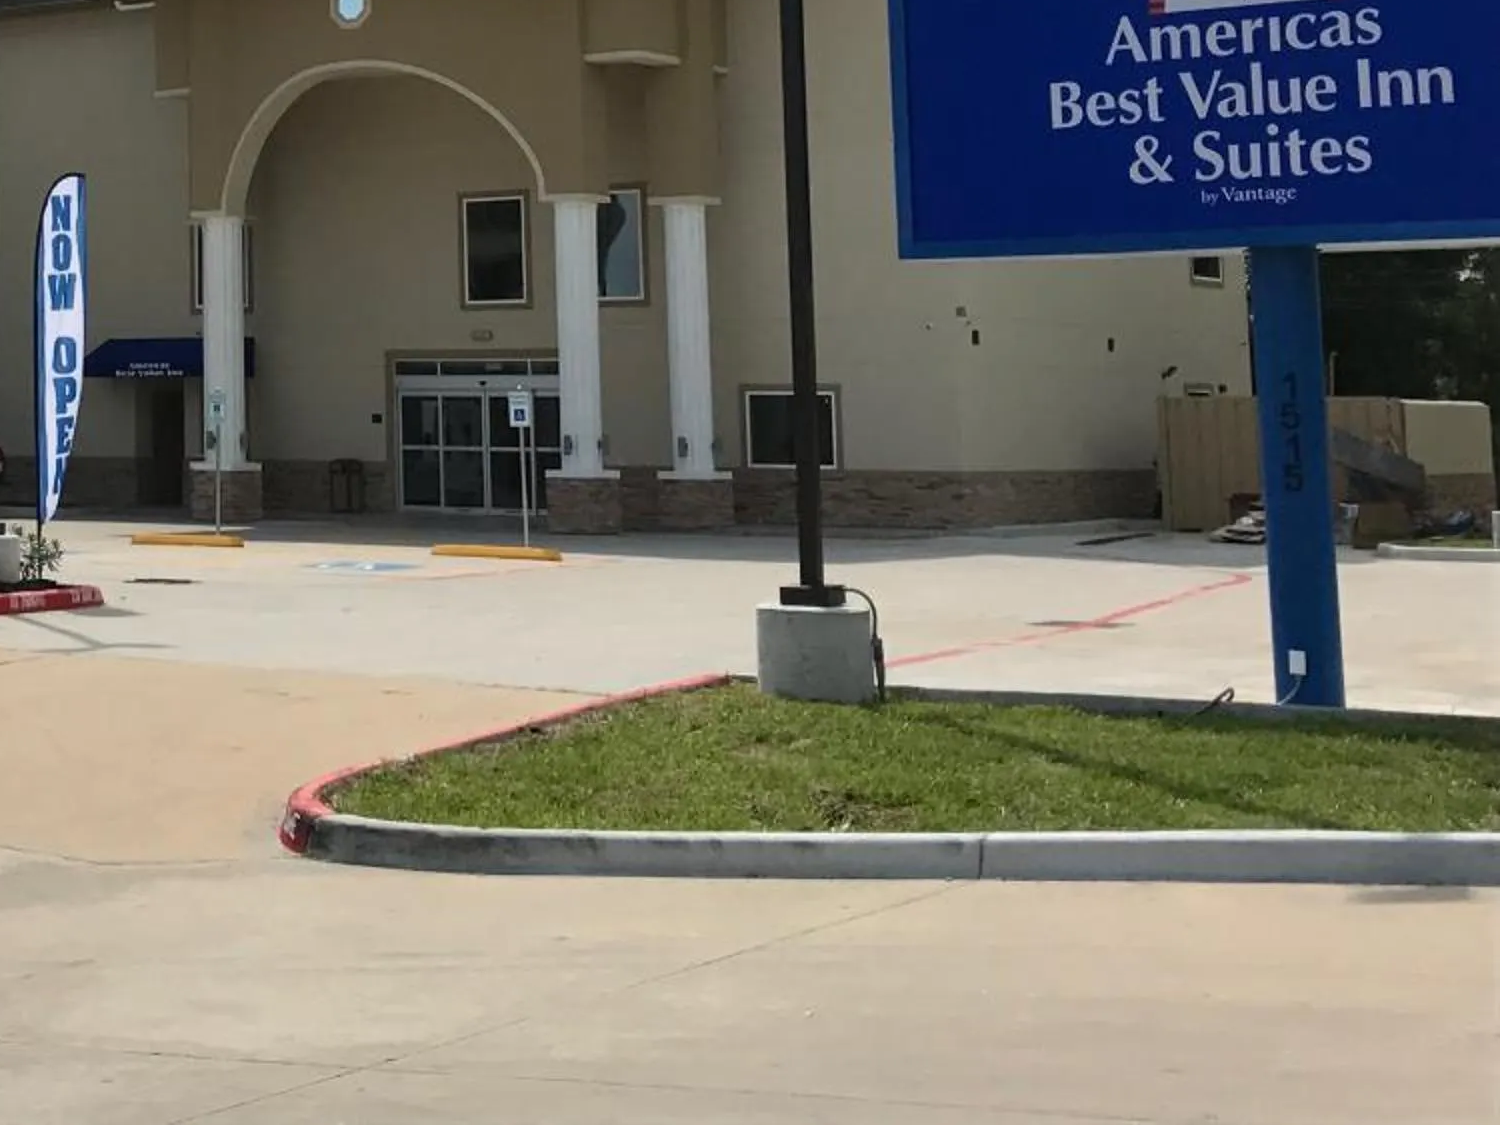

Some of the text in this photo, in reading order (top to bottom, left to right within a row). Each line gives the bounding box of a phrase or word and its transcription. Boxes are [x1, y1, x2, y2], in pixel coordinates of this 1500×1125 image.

[1105, 8, 1382, 66] Americas
[1049, 59, 1455, 129] Best Value Inn
[1129, 124, 1372, 184] & Suites
[1201, 186, 1297, 204] by Vantage
[48, 194, 77, 494] NOW OPEN
[1280, 372, 1304, 492] 1515
